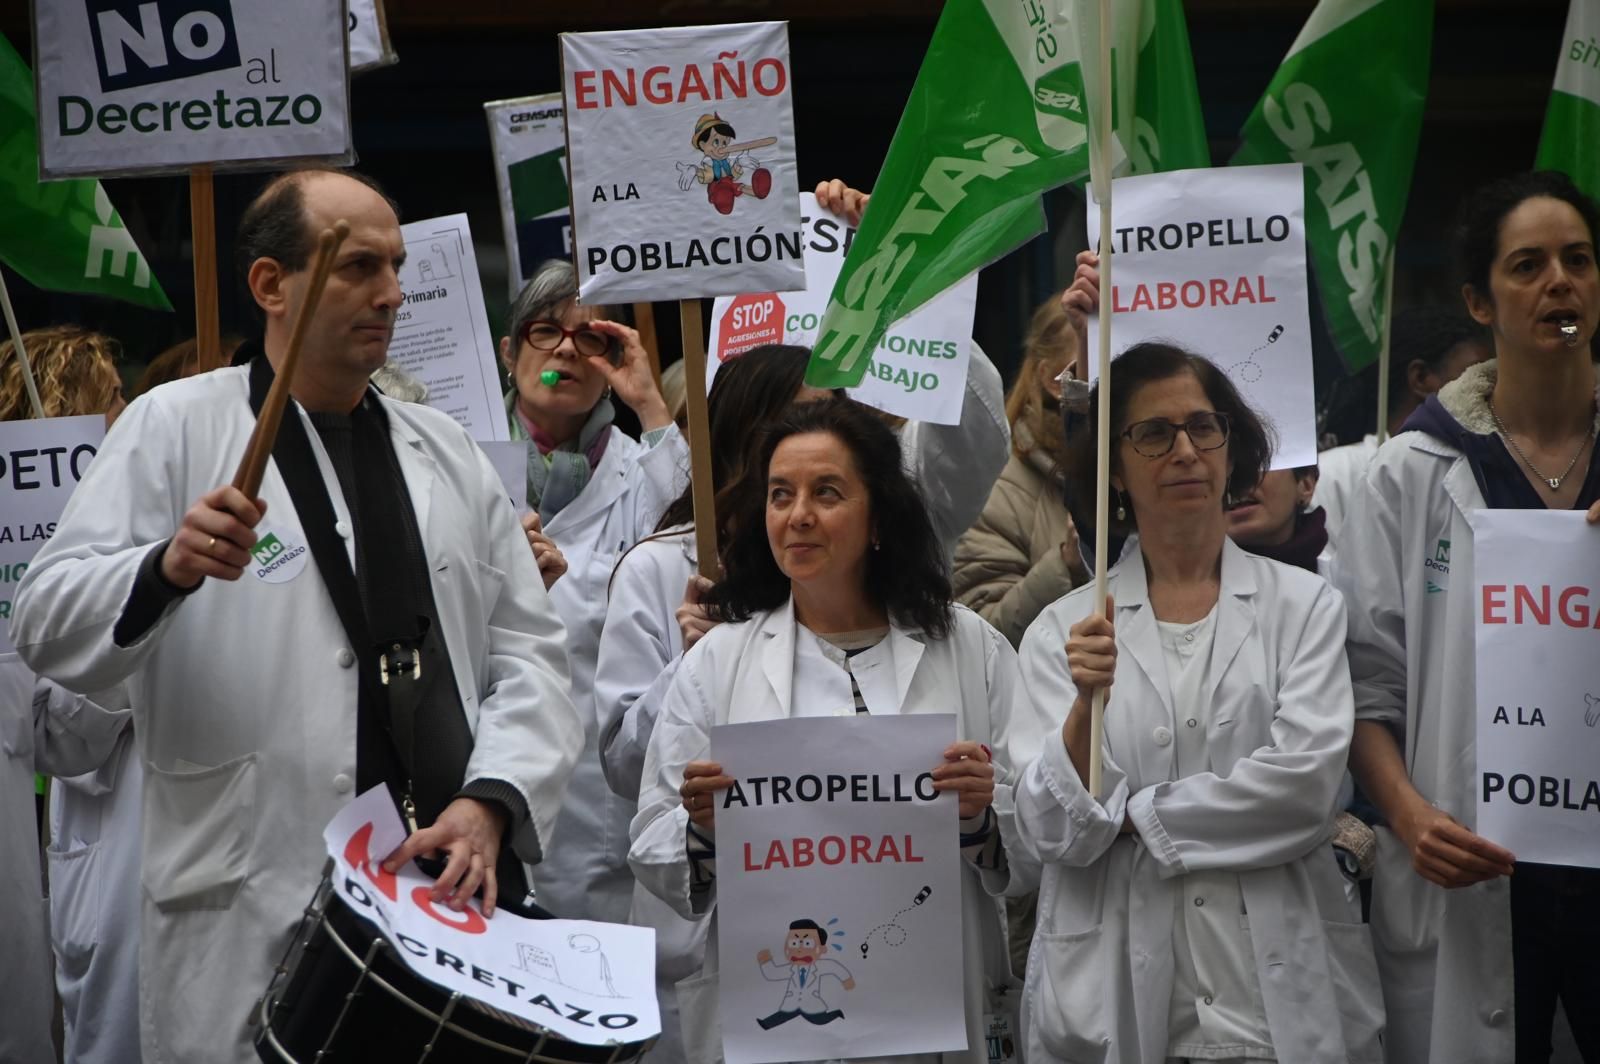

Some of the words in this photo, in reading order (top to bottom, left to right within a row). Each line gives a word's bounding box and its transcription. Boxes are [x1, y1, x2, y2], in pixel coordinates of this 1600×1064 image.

[97, 1, 226, 77] No
[246, 48, 281, 84] al
[574, 51, 786, 109] ENGAÑO
[58, 90, 322, 136] Decretazo
[592, 185, 607, 203] A
[613, 183, 640, 200] LA
[587, 226, 800, 275] POBLACIÓN
[401, 285, 447, 305] Primaria
[1112, 275, 1276, 313] LABORAL
[732, 299, 775, 330] STOP
[727, 328, 770, 345] AGRESIONES
[255, 542, 281, 563] No
[257, 546, 306, 578] Decretazo
[1493, 706, 1510, 724] A
[1517, 707, 1546, 727] LA
[723, 772, 941, 809] ATROPELLO
[744, 834, 924, 871] LABORAL
